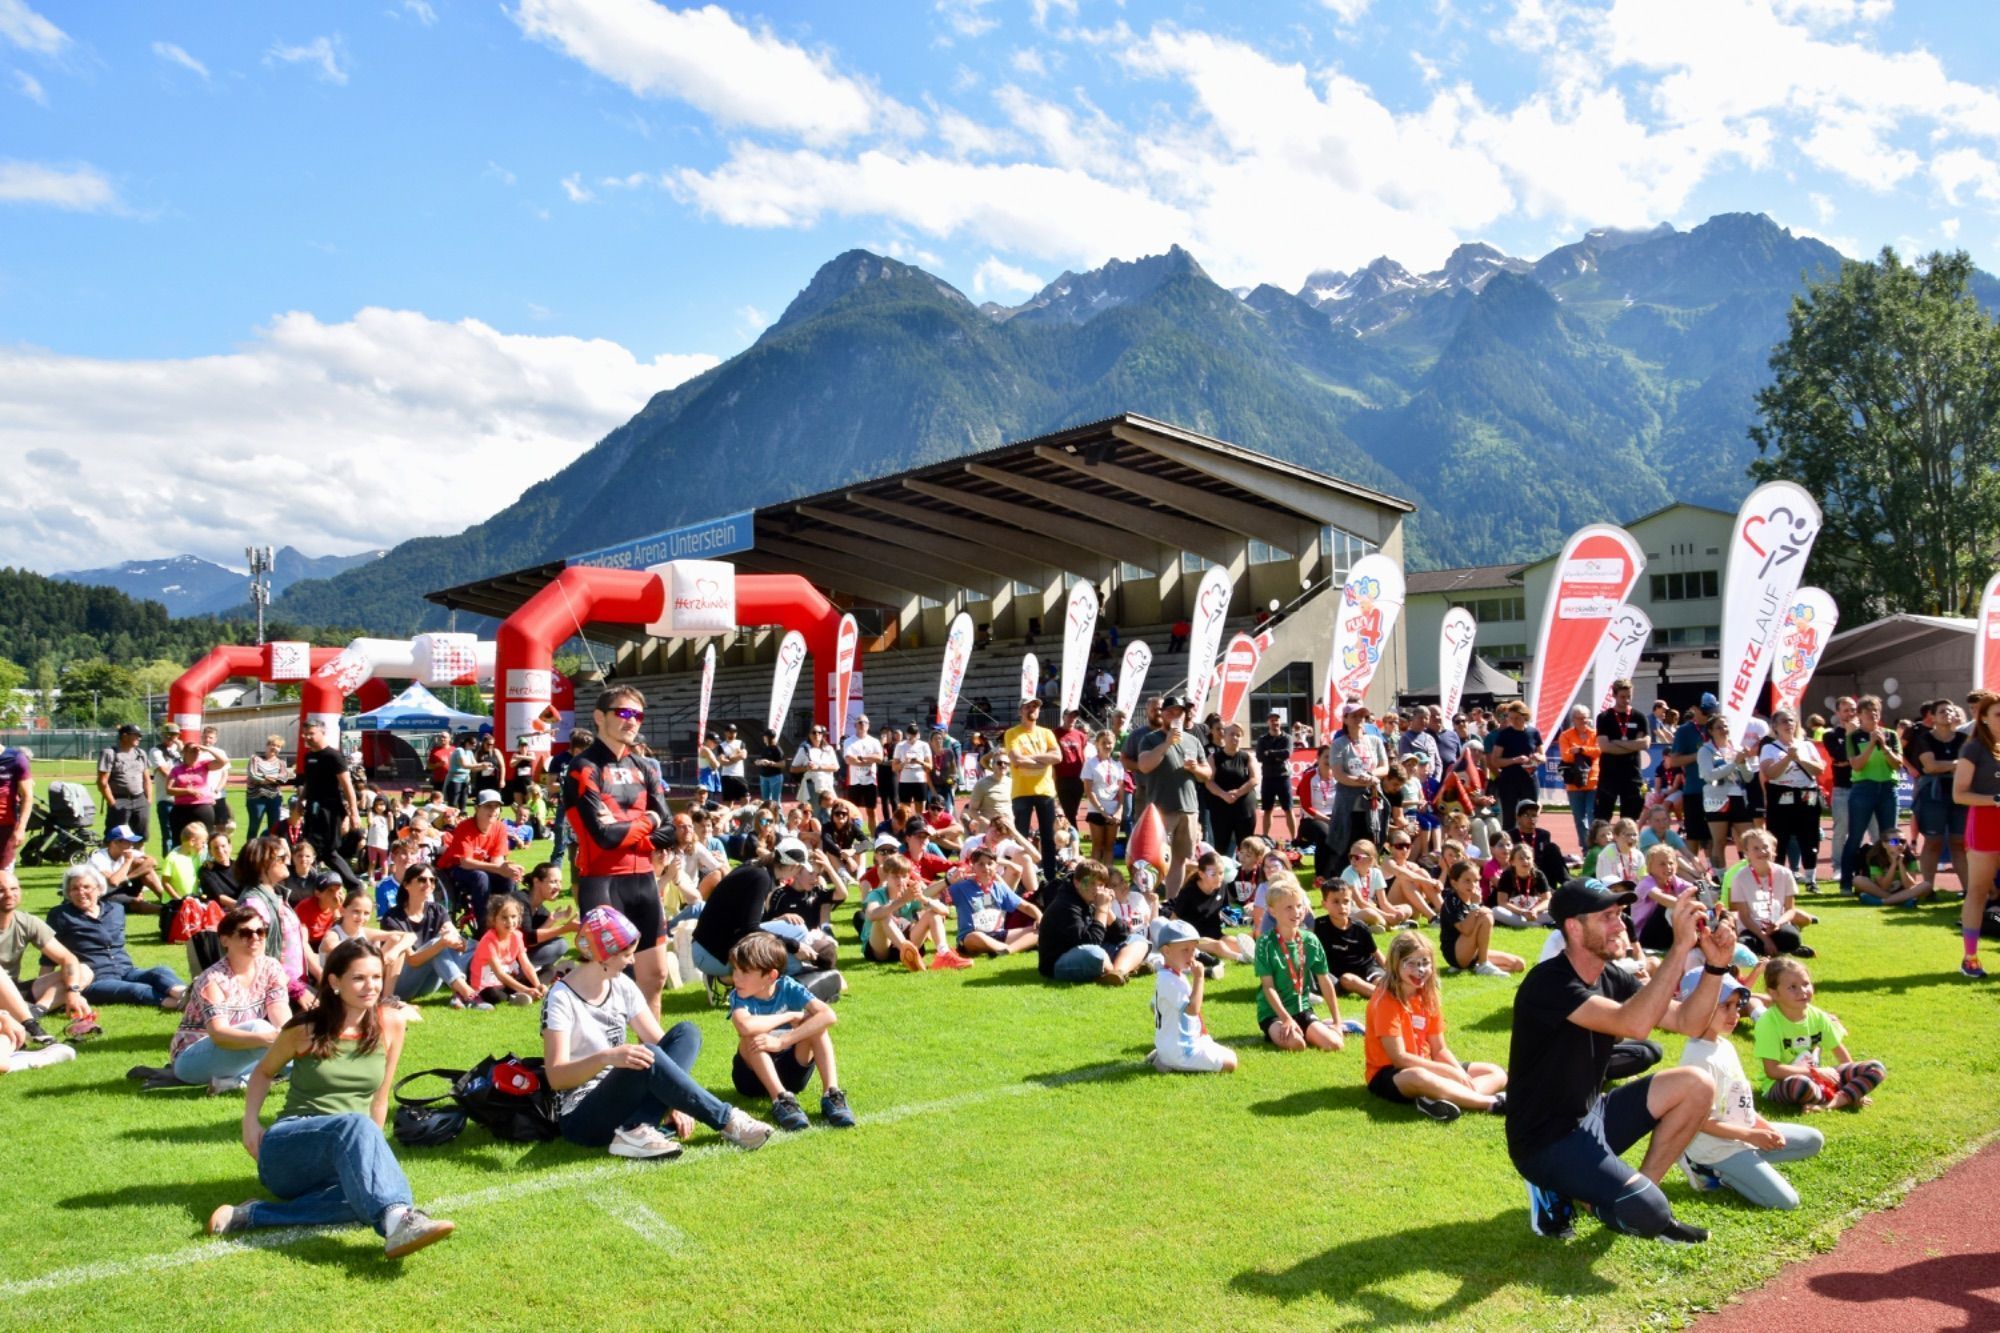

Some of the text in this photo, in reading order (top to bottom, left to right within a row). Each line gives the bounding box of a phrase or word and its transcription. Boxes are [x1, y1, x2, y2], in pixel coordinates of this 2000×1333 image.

[634, 541, 668, 566] Arena
[670, 523, 736, 557] Unterstein
[1728, 584, 1780, 711] HERZLAUF
